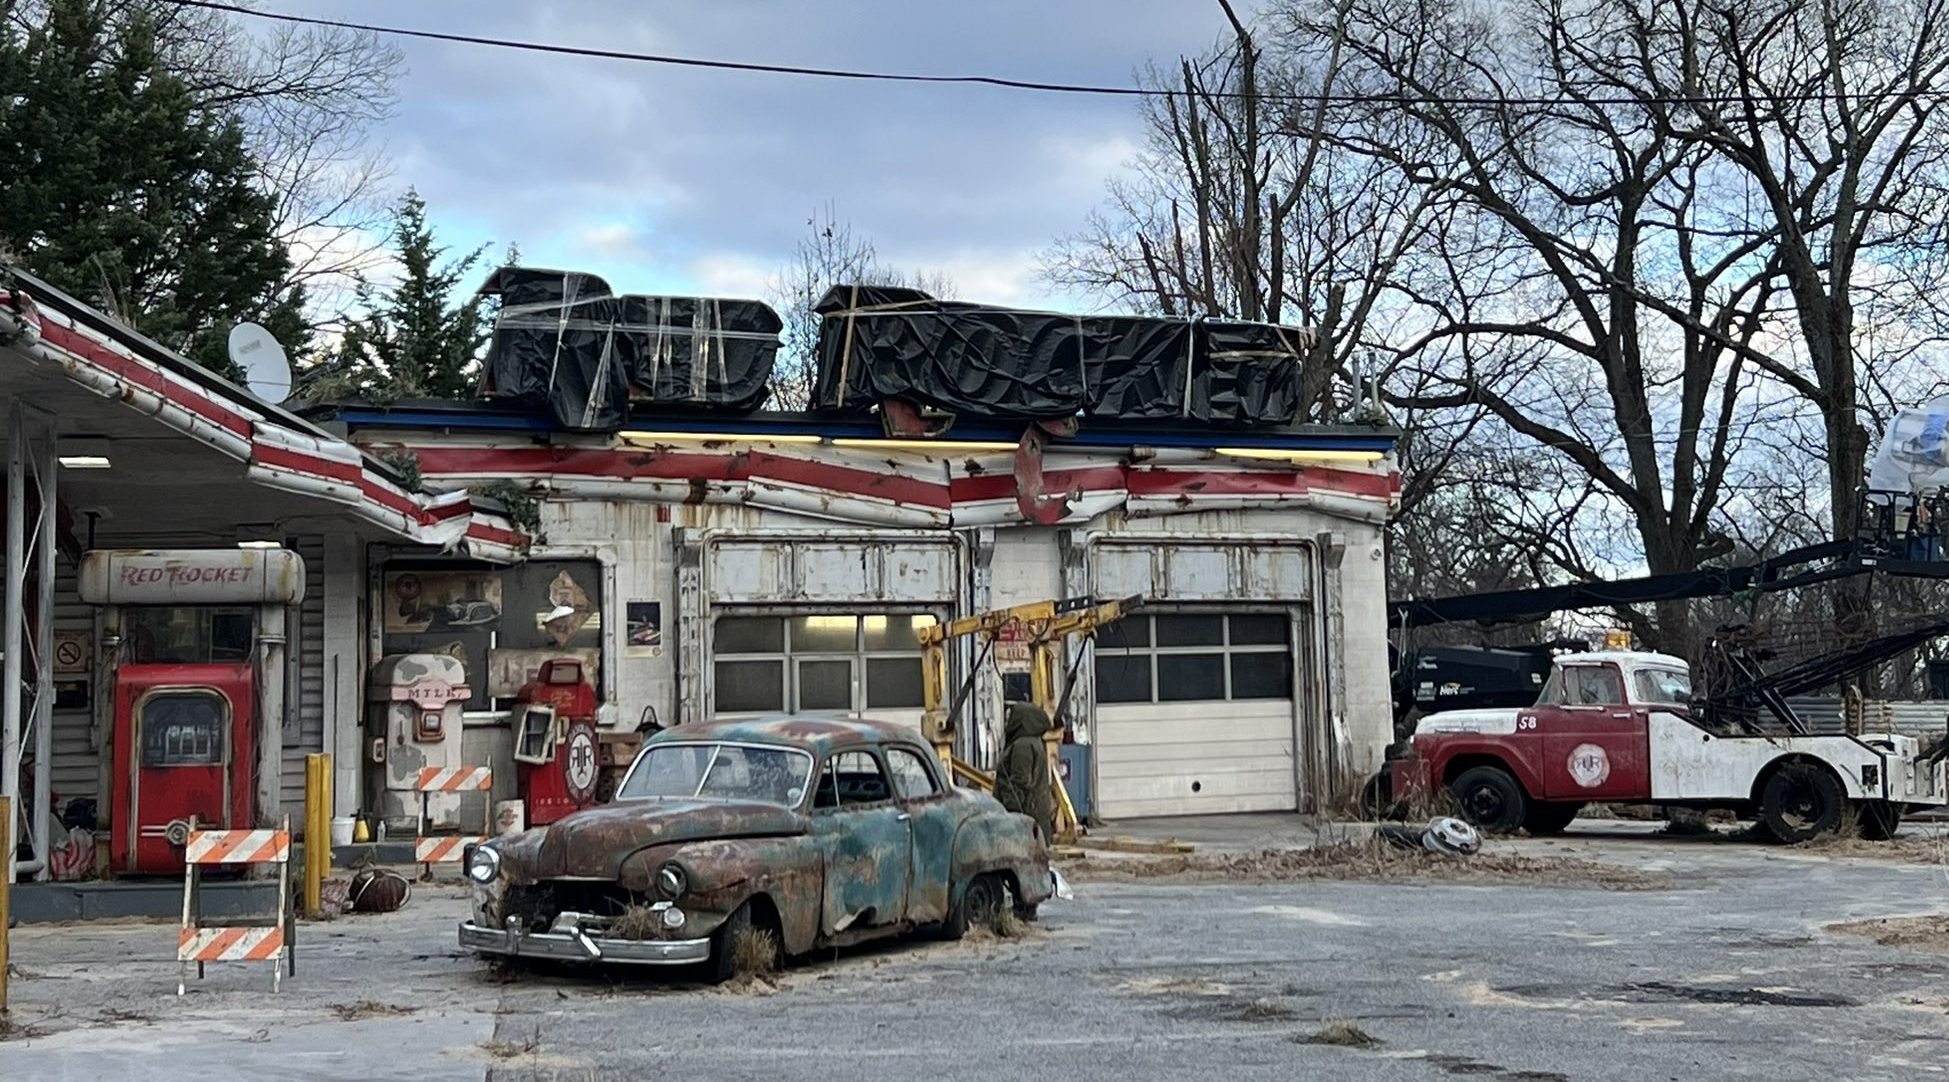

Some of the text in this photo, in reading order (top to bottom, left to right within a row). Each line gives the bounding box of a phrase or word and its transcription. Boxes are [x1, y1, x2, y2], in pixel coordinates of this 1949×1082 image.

[122, 565, 253, 586] RED ROCKET
[408, 688, 461, 699] MILK
[1519, 716, 1537, 729] 58
